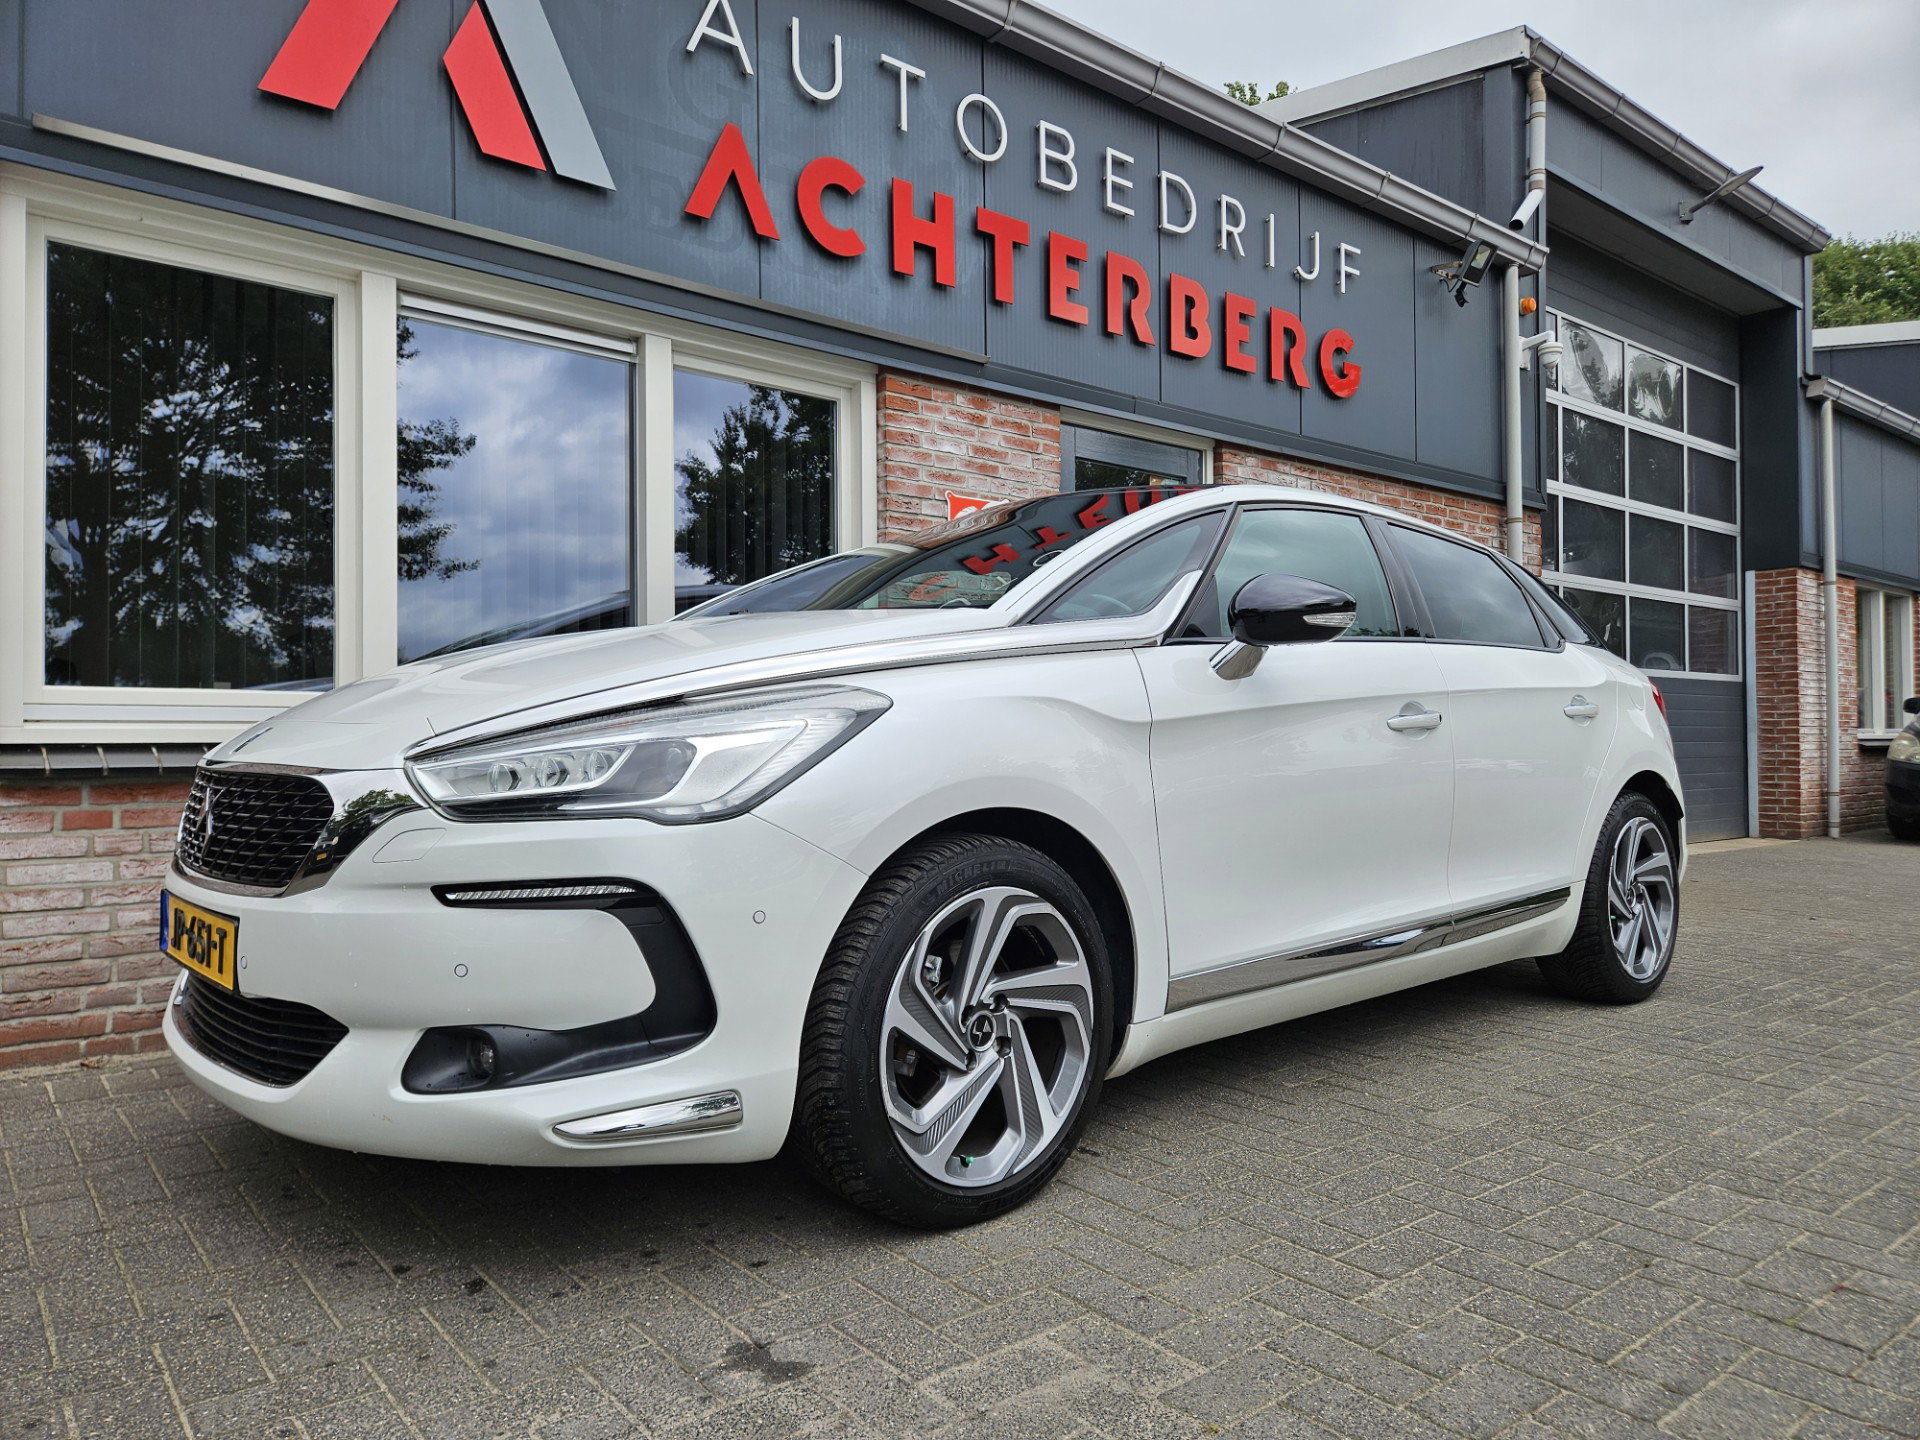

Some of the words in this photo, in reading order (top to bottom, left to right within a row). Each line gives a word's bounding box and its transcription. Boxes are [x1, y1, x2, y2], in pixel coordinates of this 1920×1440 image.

[684, 122, 1362, 399] ACHTERBERG
[686, 0, 1361, 294] AUTOBEDRIJF
[172, 907, 227, 974] JP-651-T
